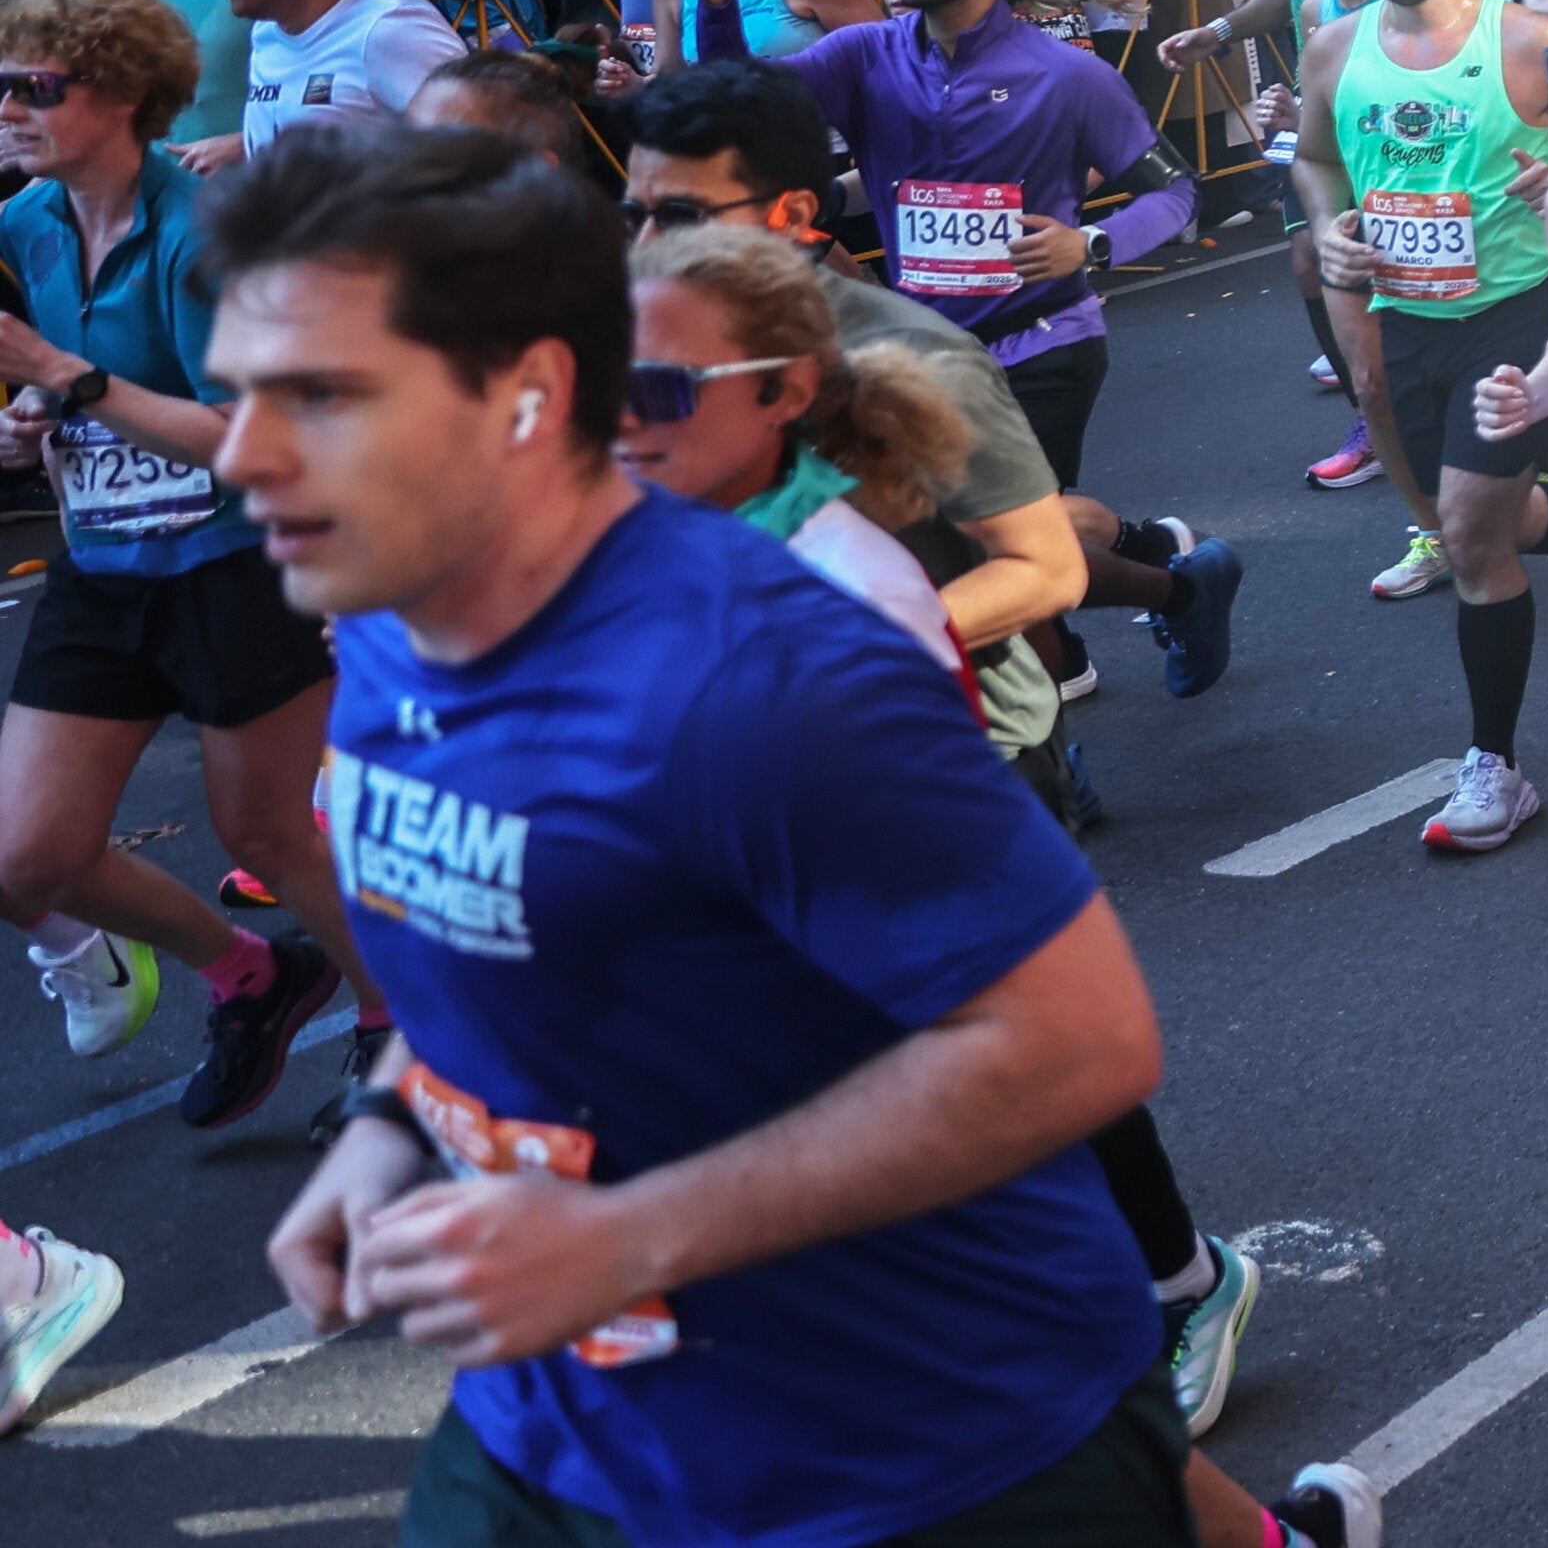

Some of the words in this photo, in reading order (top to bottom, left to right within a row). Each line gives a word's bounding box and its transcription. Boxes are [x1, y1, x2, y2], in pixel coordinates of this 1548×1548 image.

[910, 185, 935, 204] tcs
[1372, 194, 1394, 213] tcs
[904, 209, 1013, 247] 13484
[1370, 217, 1466, 254] 27933
[1395, 255, 1433, 266] MARCO
[365, 762, 532, 890] TEAM
